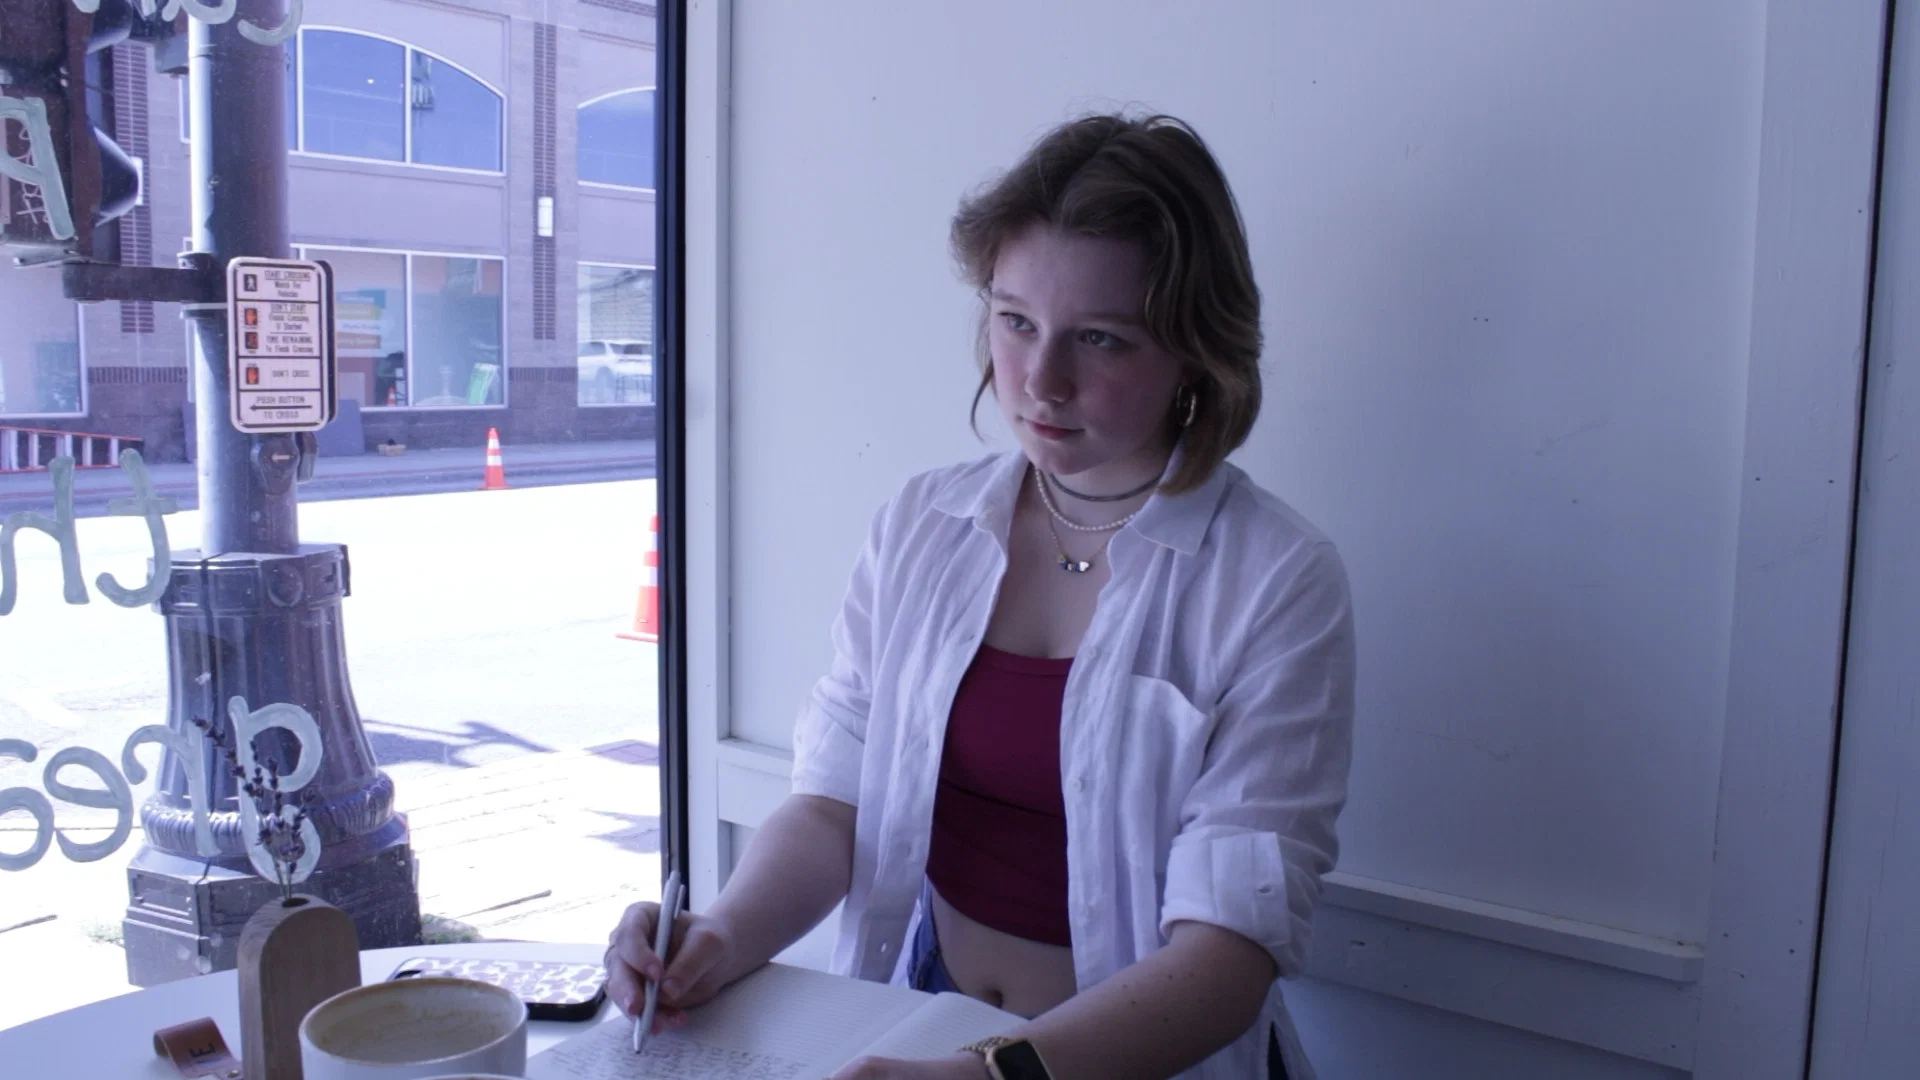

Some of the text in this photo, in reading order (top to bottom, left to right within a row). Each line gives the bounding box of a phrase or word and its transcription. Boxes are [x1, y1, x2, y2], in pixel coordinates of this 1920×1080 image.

[256, 396, 305, 404] PUSH BUTTON
[264, 411, 300, 419] TO CROSS
